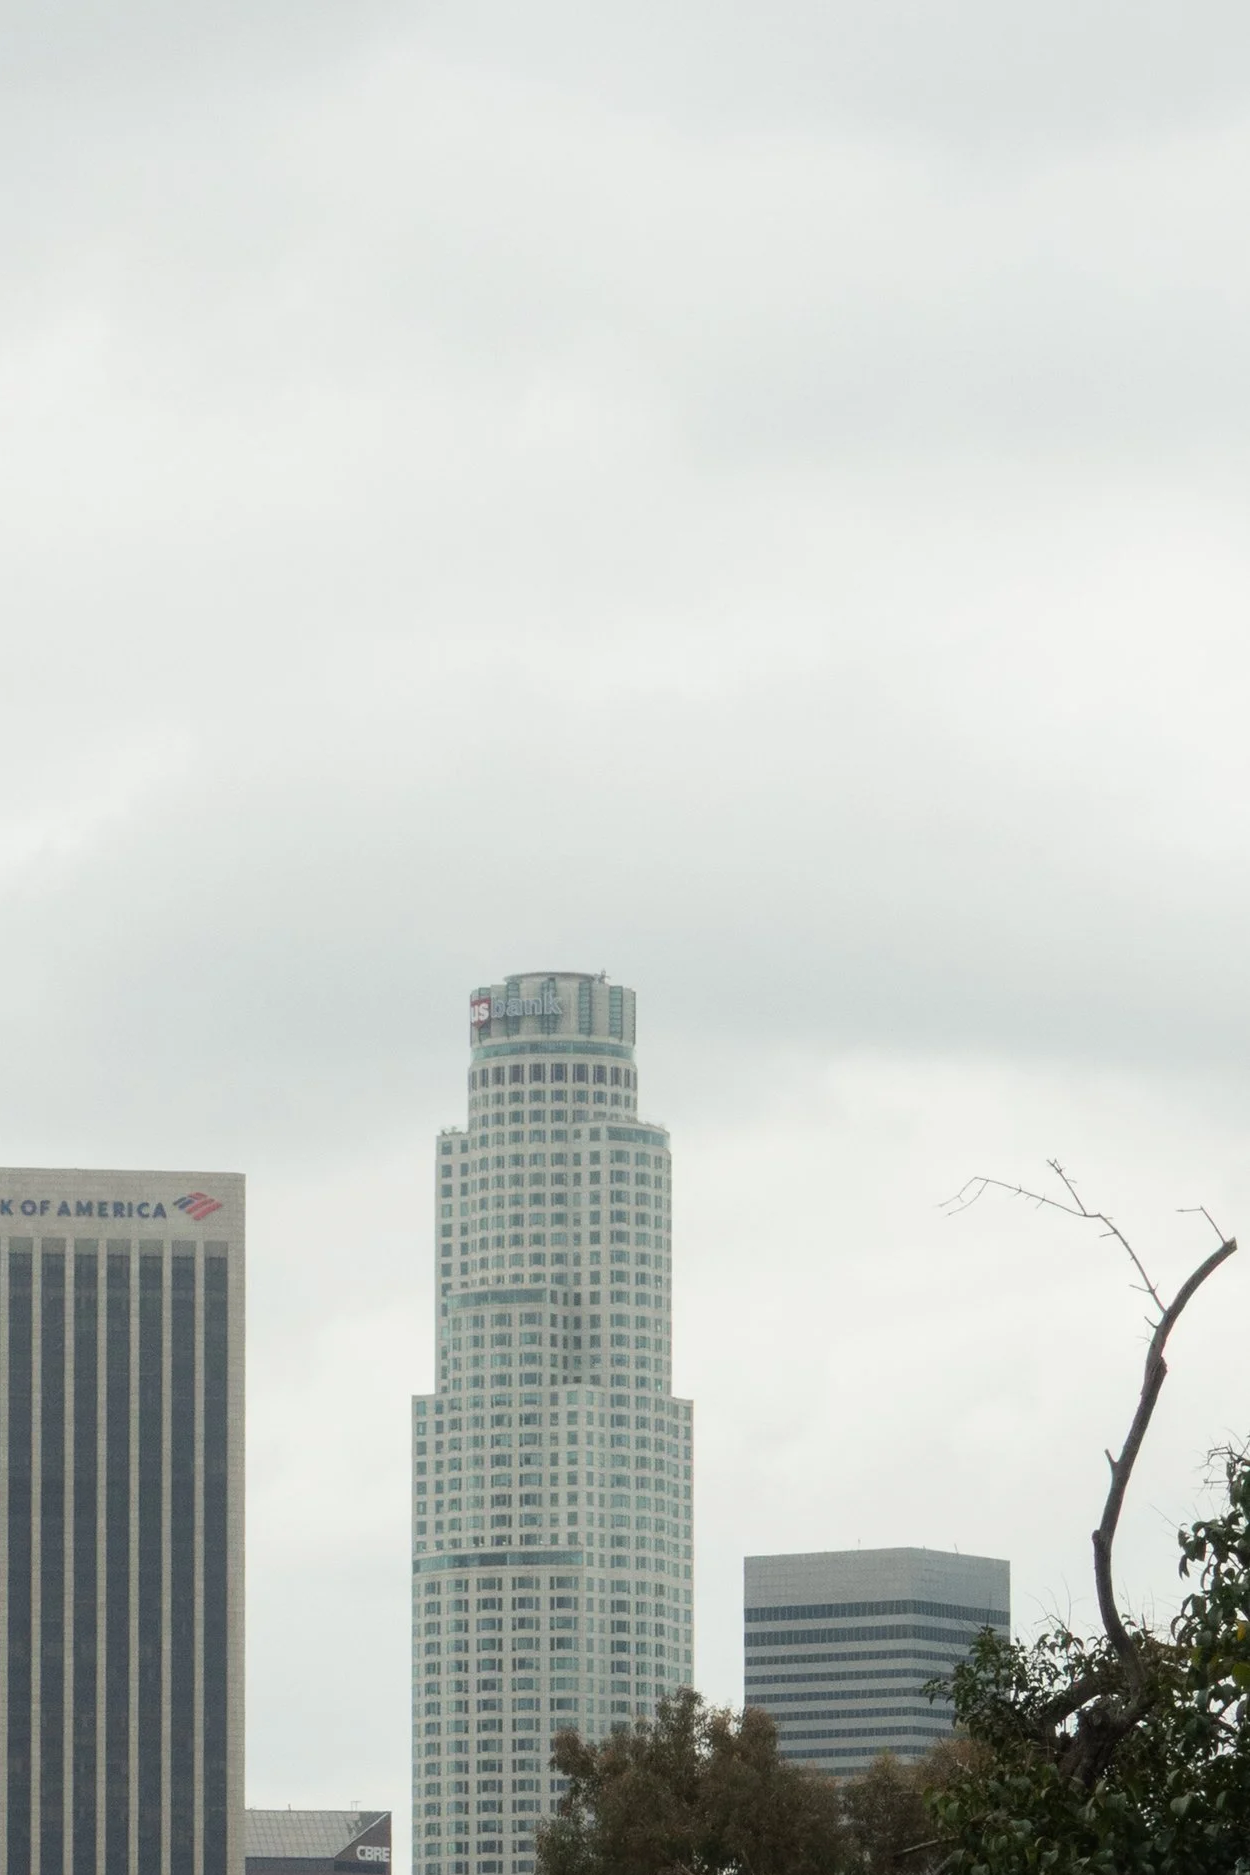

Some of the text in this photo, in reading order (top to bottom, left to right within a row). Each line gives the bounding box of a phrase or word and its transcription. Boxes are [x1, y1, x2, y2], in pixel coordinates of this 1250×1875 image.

[491, 991, 563, 1018] bank
[21, 1199, 51, 1217] OF
[56, 1200, 168, 1219] AMERICA
[356, 1845, 391, 1862] CBRE
